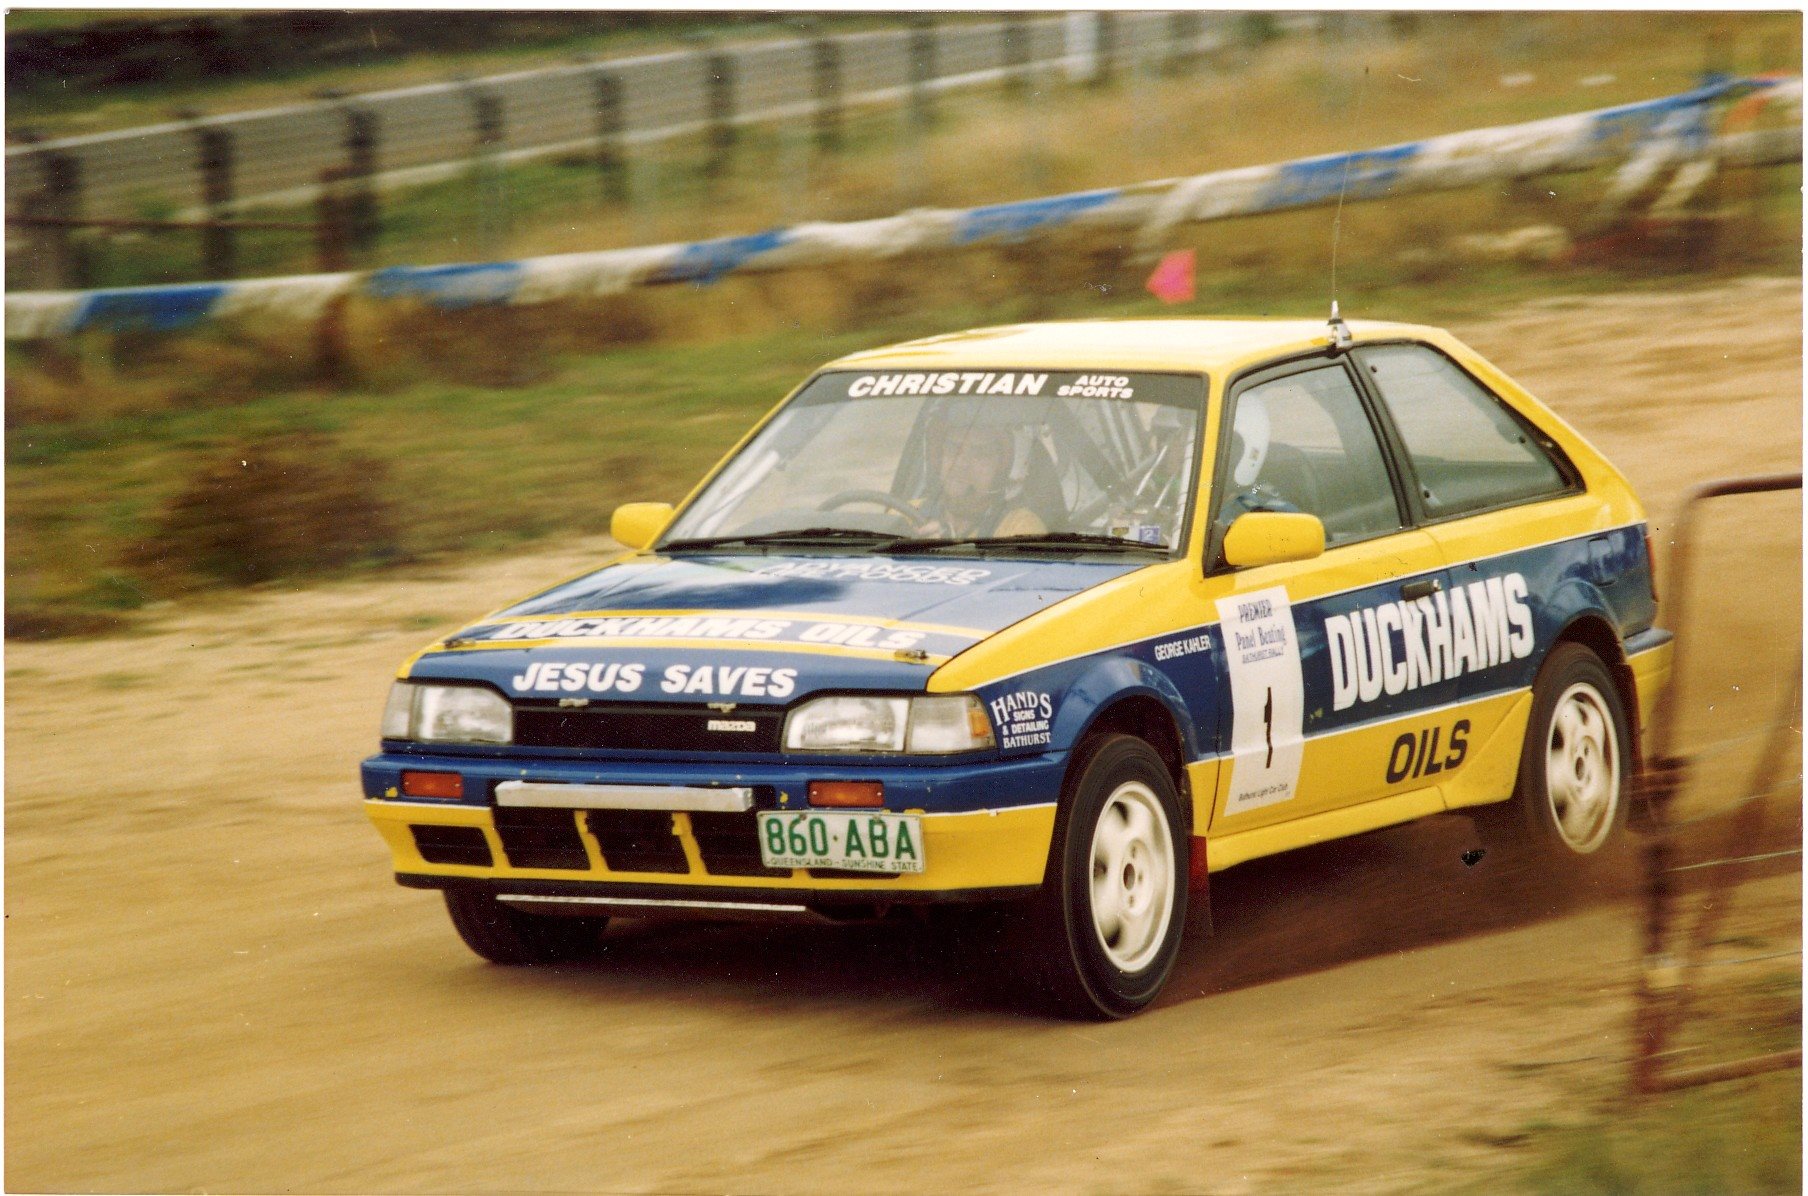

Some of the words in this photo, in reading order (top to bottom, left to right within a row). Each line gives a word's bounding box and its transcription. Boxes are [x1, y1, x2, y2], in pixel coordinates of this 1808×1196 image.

[848, 373, 1048, 397] CHRISTIAN
[1057, 385, 1134, 399] SPORTS
[1074, 375, 1129, 387] AUTO
[1238, 599, 1272, 623] PREMIER
[490, 617, 793, 640] DUCKHAMS
[798, 623, 927, 648] OILS
[1235, 629, 1256, 651] Panel
[1324, 572, 1535, 712] DUCKHAMS
[1154, 640, 1184, 661] GEORGE
[1183, 634, 1212, 655] KAHLER
[512, 662, 646, 693] JESUS
[660, 664, 797, 698] SAVES
[990, 691, 1053, 726] HANDS
[1013, 709, 1036, 722] SIGNS
[1002, 725, 1009, 736] &
[1011, 720, 1049, 735] DETAILING
[1263, 687, 1273, 768] 1
[1003, 732, 1051, 749] BATHURST
[1386, 719, 1471, 784] OILS
[769, 857, 833, 867] QUEENSLAND
[841, 859, 885, 870] SUNSHINE
[891, 861, 918, 871] STATE
